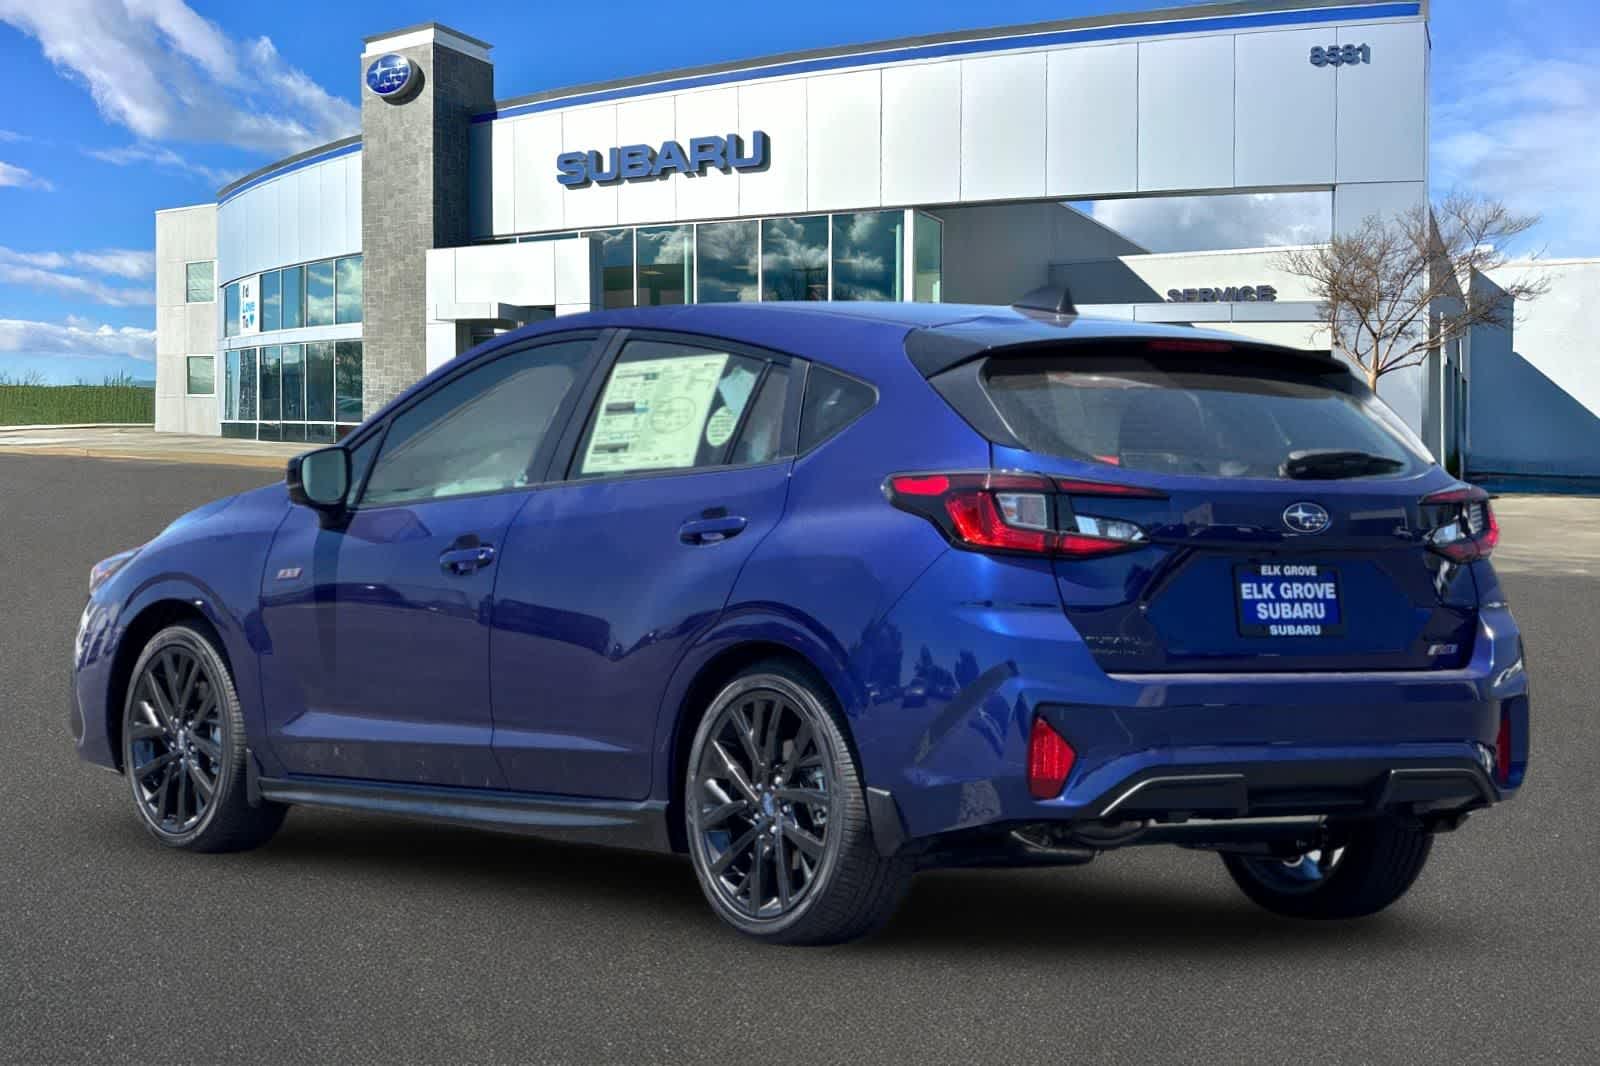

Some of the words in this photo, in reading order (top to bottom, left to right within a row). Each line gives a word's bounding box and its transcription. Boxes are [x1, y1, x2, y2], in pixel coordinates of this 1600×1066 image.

[556, 130, 769, 189] SUBARU
[1167, 285, 1277, 303] SERVICE
[1261, 565, 1281, 576] ELK
[1283, 565, 1317, 576] GROVE
[1241, 583, 1275, 599] ELK
[1280, 583, 1336, 599] GROVE
[1256, 602, 1325, 619] SUBARU
[1270, 624, 1321, 636] SUBARU
